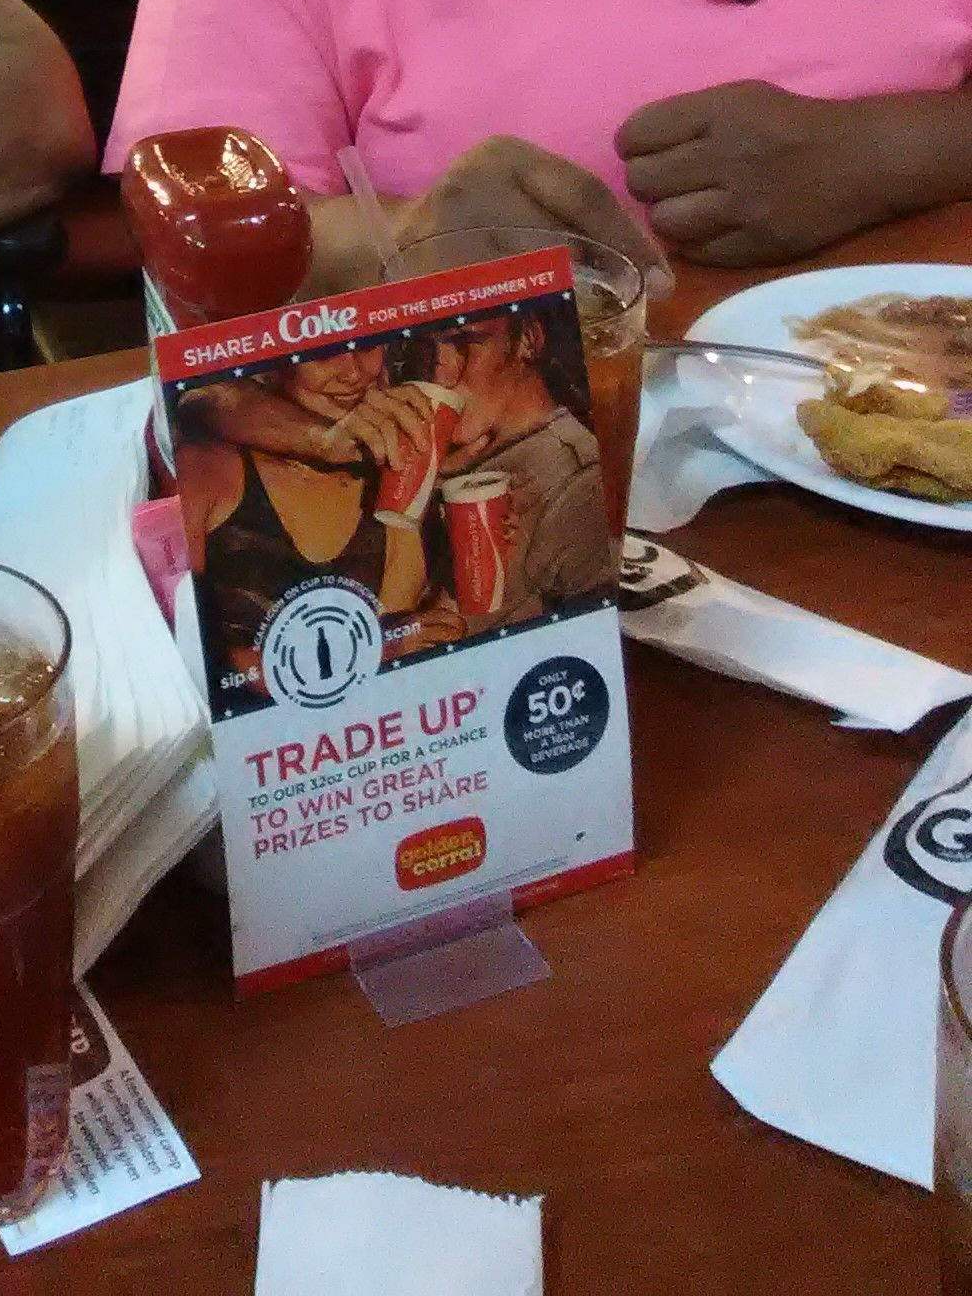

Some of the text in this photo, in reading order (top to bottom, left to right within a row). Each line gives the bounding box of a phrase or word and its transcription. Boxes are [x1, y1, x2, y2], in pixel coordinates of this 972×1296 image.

[183, 271, 556, 367] SHARE A Coke FOR THE BEST SUMMER YET
[300, 577, 320, 591] CUP
[322, 575, 335, 584] TO
[384, 621, 421, 642] scan
[539, 670, 568, 686] ONLY
[246, 711, 405, 788] TRADE
[248, 791, 271, 809] TO
[273, 782, 308, 803] OUR
[346, 761, 379, 782] CUP
[380, 752, 412, 770] FOR
[414, 747, 426, 761] A
[428, 727, 489, 756] CHANCE
[251, 758, 448, 834] TO WIN GREAT
[254, 771, 489, 859] PRIZES TO SHARE
[413, 840, 482, 875] corral
[116, 1150, 141, 1182] given
[133, 1131, 162, 1175] children
[159, 1138, 181, 1171] camp
